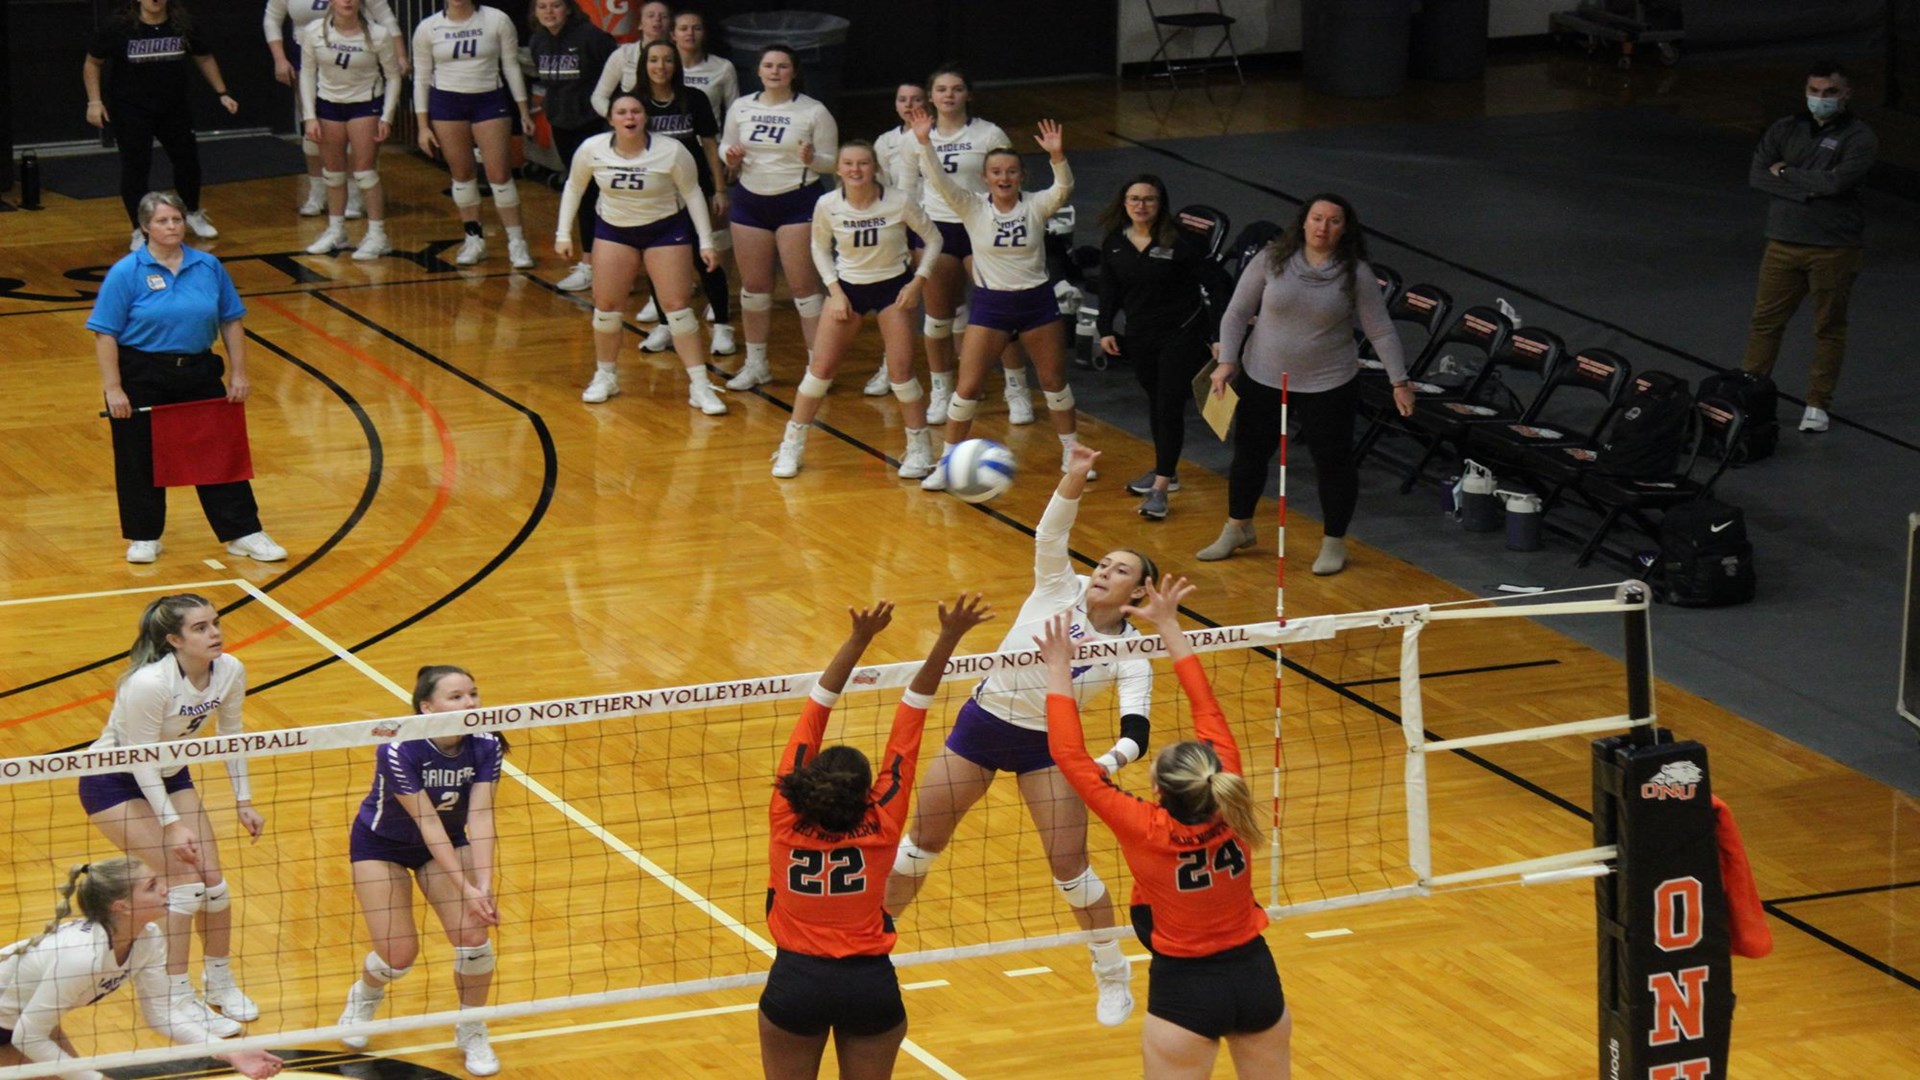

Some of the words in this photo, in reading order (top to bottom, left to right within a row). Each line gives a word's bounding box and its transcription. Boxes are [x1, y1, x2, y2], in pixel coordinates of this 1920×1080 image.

[445, 28, 483, 39] RAIDERS
[452, 39, 477, 59] 14
[335, 52, 351, 69] 4
[751, 115, 791, 126] RAIDERS
[749, 124, 786, 144] 24
[936, 142, 973, 153] AIDERS
[943, 153, 960, 174] 5
[611, 173, 645, 191] 25
[843, 217, 887, 228] RAIDERS
[853, 228, 878, 248] 10
[993, 225, 1028, 247] 22
[1001, 642, 1118, 669] NORERN
[1125, 628, 1250, 654] VOLYBALL
[463, 707, 521, 727] OHIO
[529, 693, 653, 721] NORTHERN
[660, 679, 792, 706] VOLLEYBALL
[28, 747, 160, 775] NORTHERN
[168, 731, 307, 760] VOLLEYBALL
[435, 791, 460, 811] 2
[1641, 782, 1698, 800] ONU
[787, 846, 867, 896] 22
[1175, 837, 1247, 892] 24
